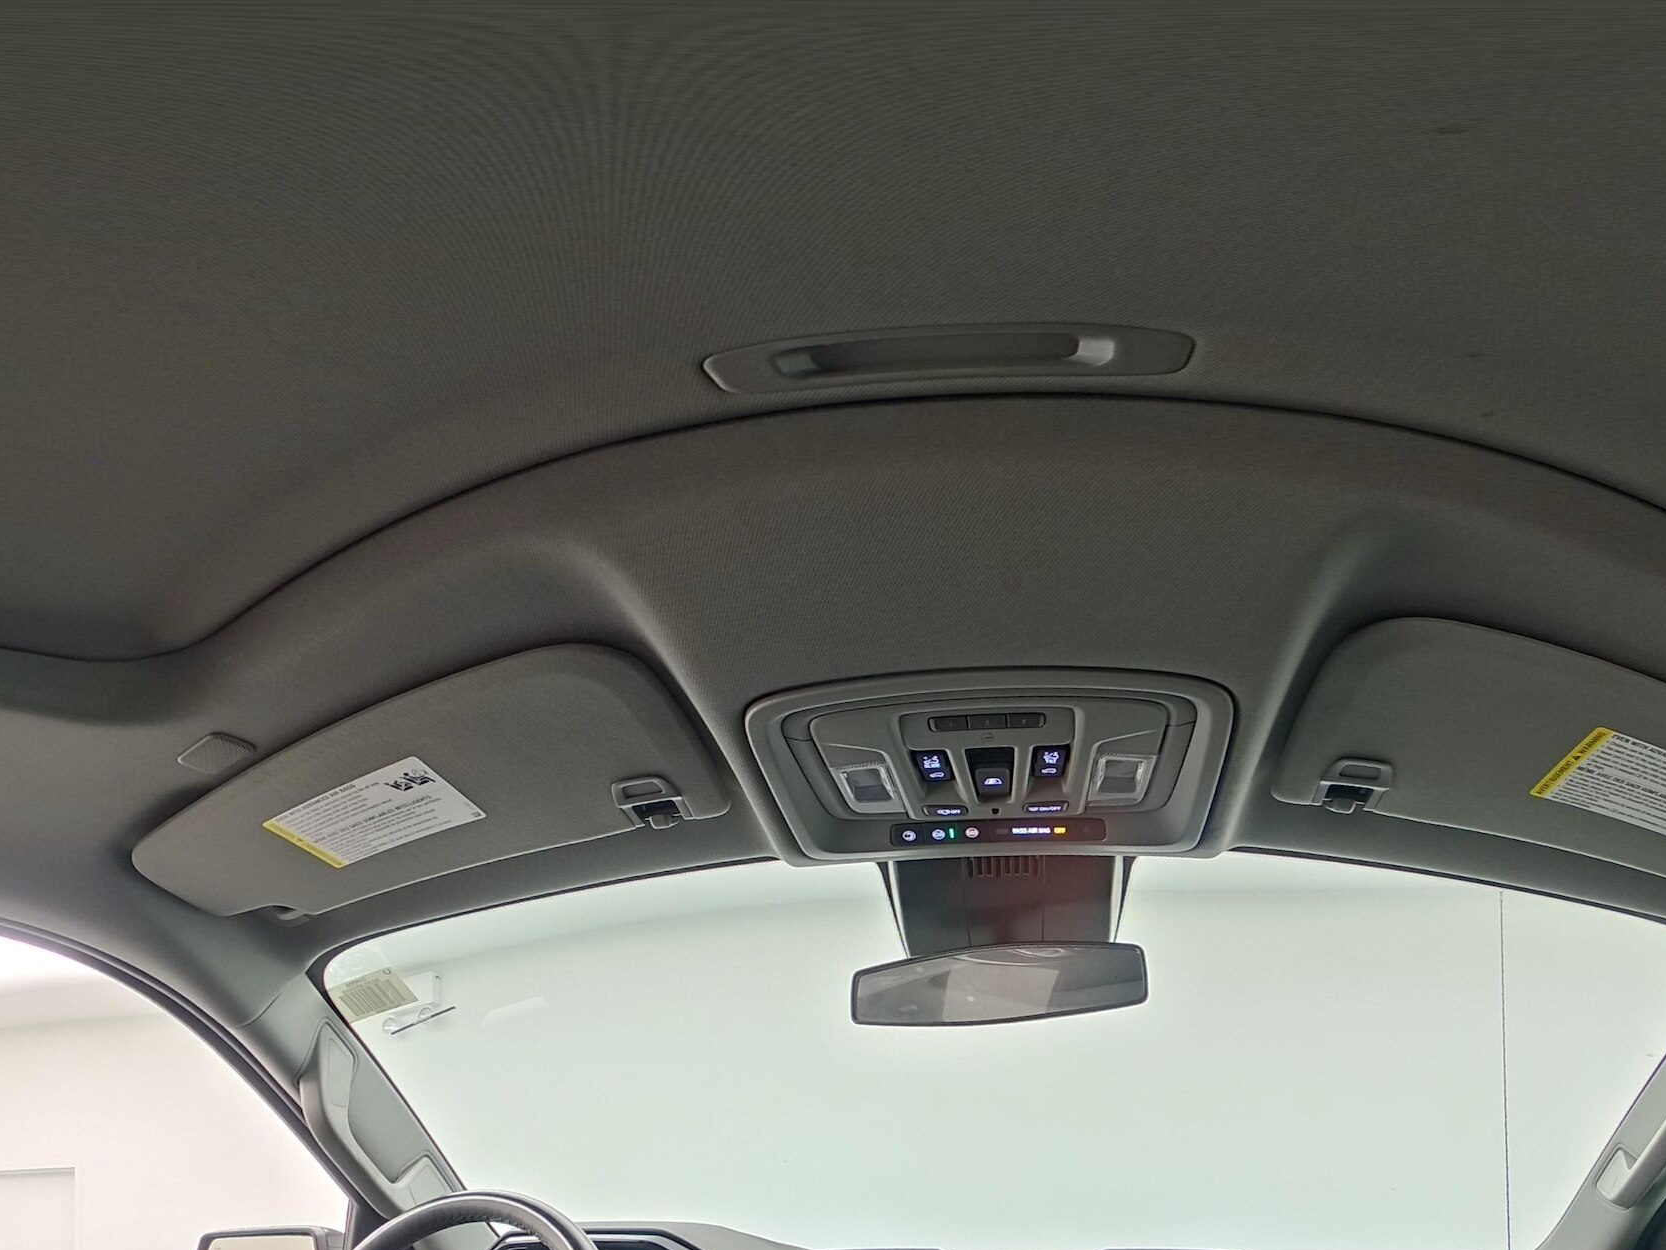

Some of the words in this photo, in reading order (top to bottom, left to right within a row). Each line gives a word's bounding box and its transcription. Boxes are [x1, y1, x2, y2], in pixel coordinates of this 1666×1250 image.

[1580, 731, 1606, 755] WARNING
[1612, 734, 1630, 743] EVEN
[1631, 740, 1649, 750] WITH
[1536, 760, 1574, 795] AVERTISSEMENT
[300, 795, 330, 809] ADVANCED
[336, 783, 356, 793] BAGS
